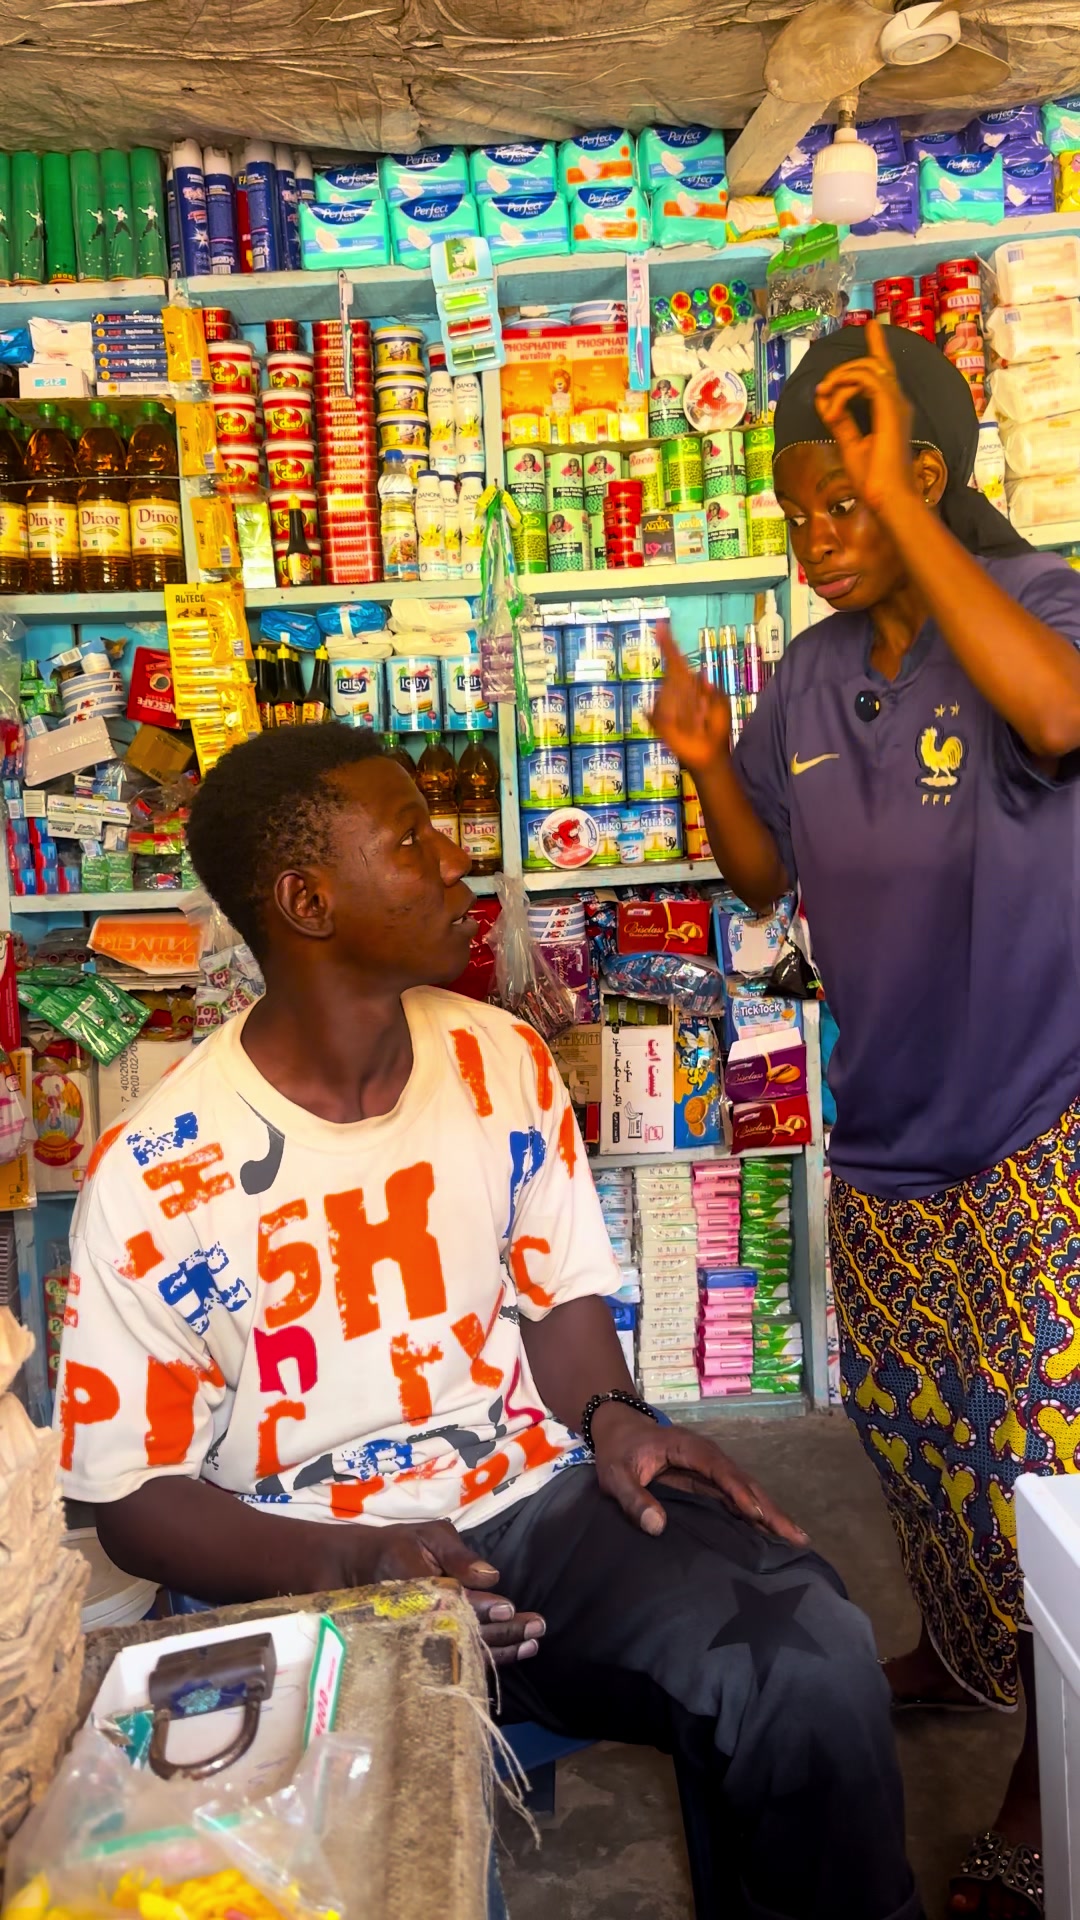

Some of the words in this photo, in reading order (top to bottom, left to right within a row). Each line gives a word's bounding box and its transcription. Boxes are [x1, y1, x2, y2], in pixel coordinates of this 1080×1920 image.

[580, 133, 613, 146] Perfect
[668, 130, 701, 143] Perfect
[405, 153, 441, 165] Perfect
[946, 158, 982, 173] Perfect
[323, 205, 359, 222] Perfect
[414, 203, 449, 219] Perfect
[507, 201, 543, 216] Perfect
[504, 340, 567, 351] PHOSPHATINE
[577, 336, 628, 348] PHOSPHATI
[217, 414, 235, 426] Top
[273, 410, 291, 422] Top
[276, 462, 293, 474] Top
[418, 491, 442, 499] DANONE
[28, 511, 65, 527] Dinor
[82, 509, 121, 525] Dinor
[139, 507, 179, 524] Dinor
[338, 678, 365, 691] laity
[464, 822, 496, 835] Dinor
[641, 817, 672, 827] MILKO
[98, 936, 195, 951] MILLIMETRE
[196, 1005, 217, 1018] Top
